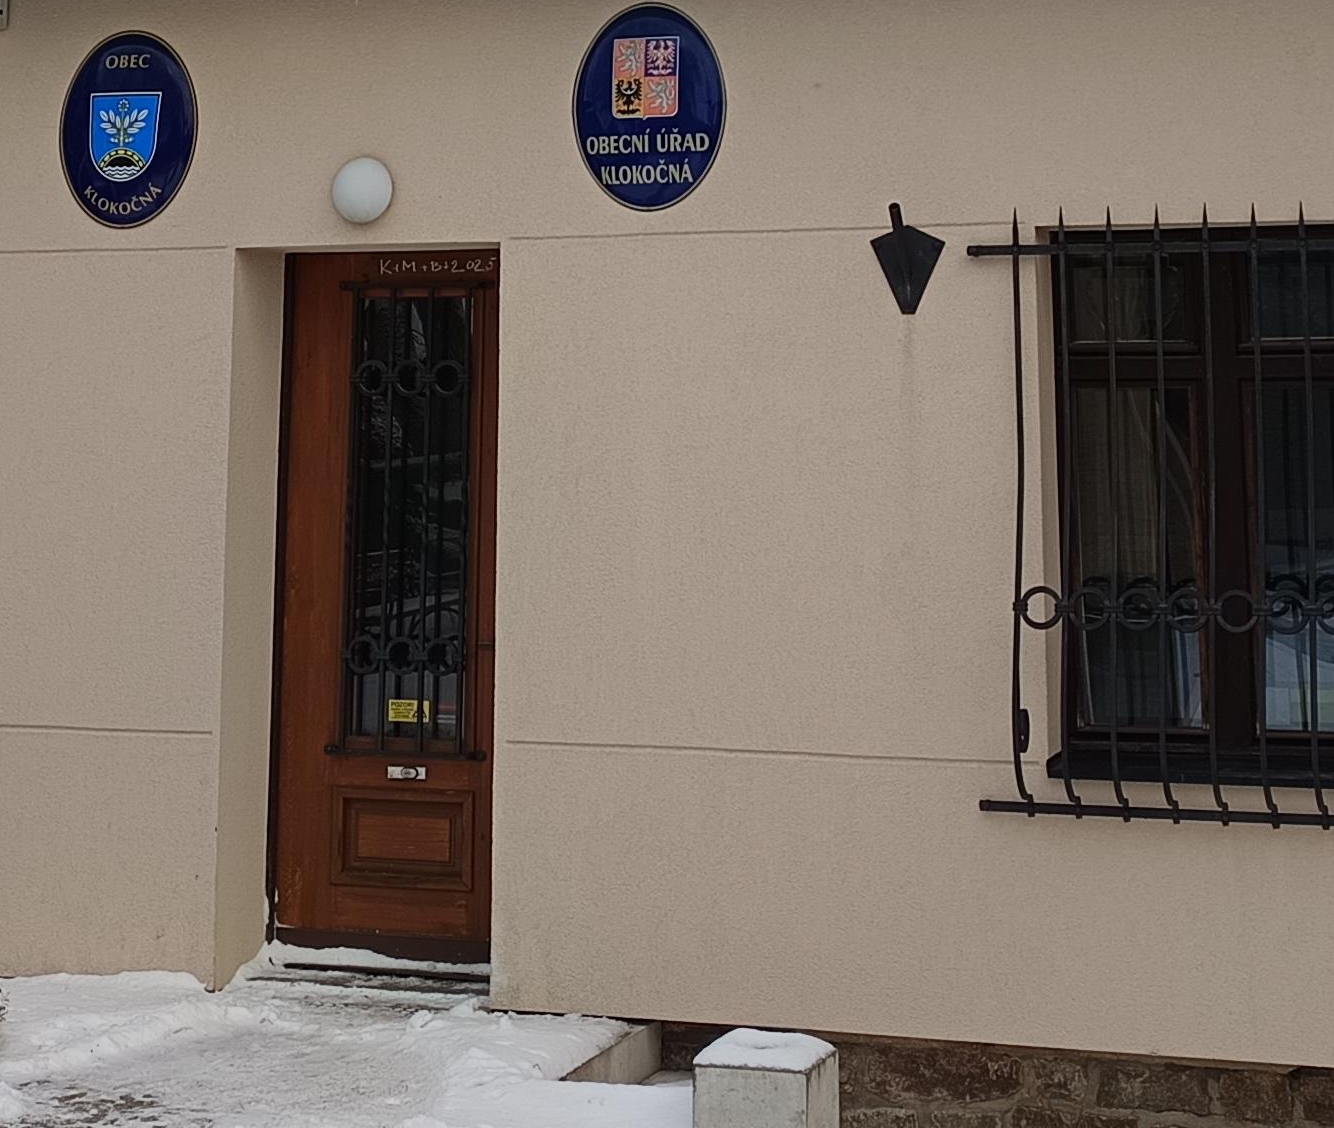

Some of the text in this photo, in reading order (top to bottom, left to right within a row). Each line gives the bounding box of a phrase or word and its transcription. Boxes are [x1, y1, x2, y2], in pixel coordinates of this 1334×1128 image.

[105, 54, 151, 69] OBEC
[586, 127, 710, 155] OBECNÍ ÚŘAD
[600, 158, 694, 185] KLOKOČNÁ
[83, 181, 162, 215] KLOKOČNÁ
